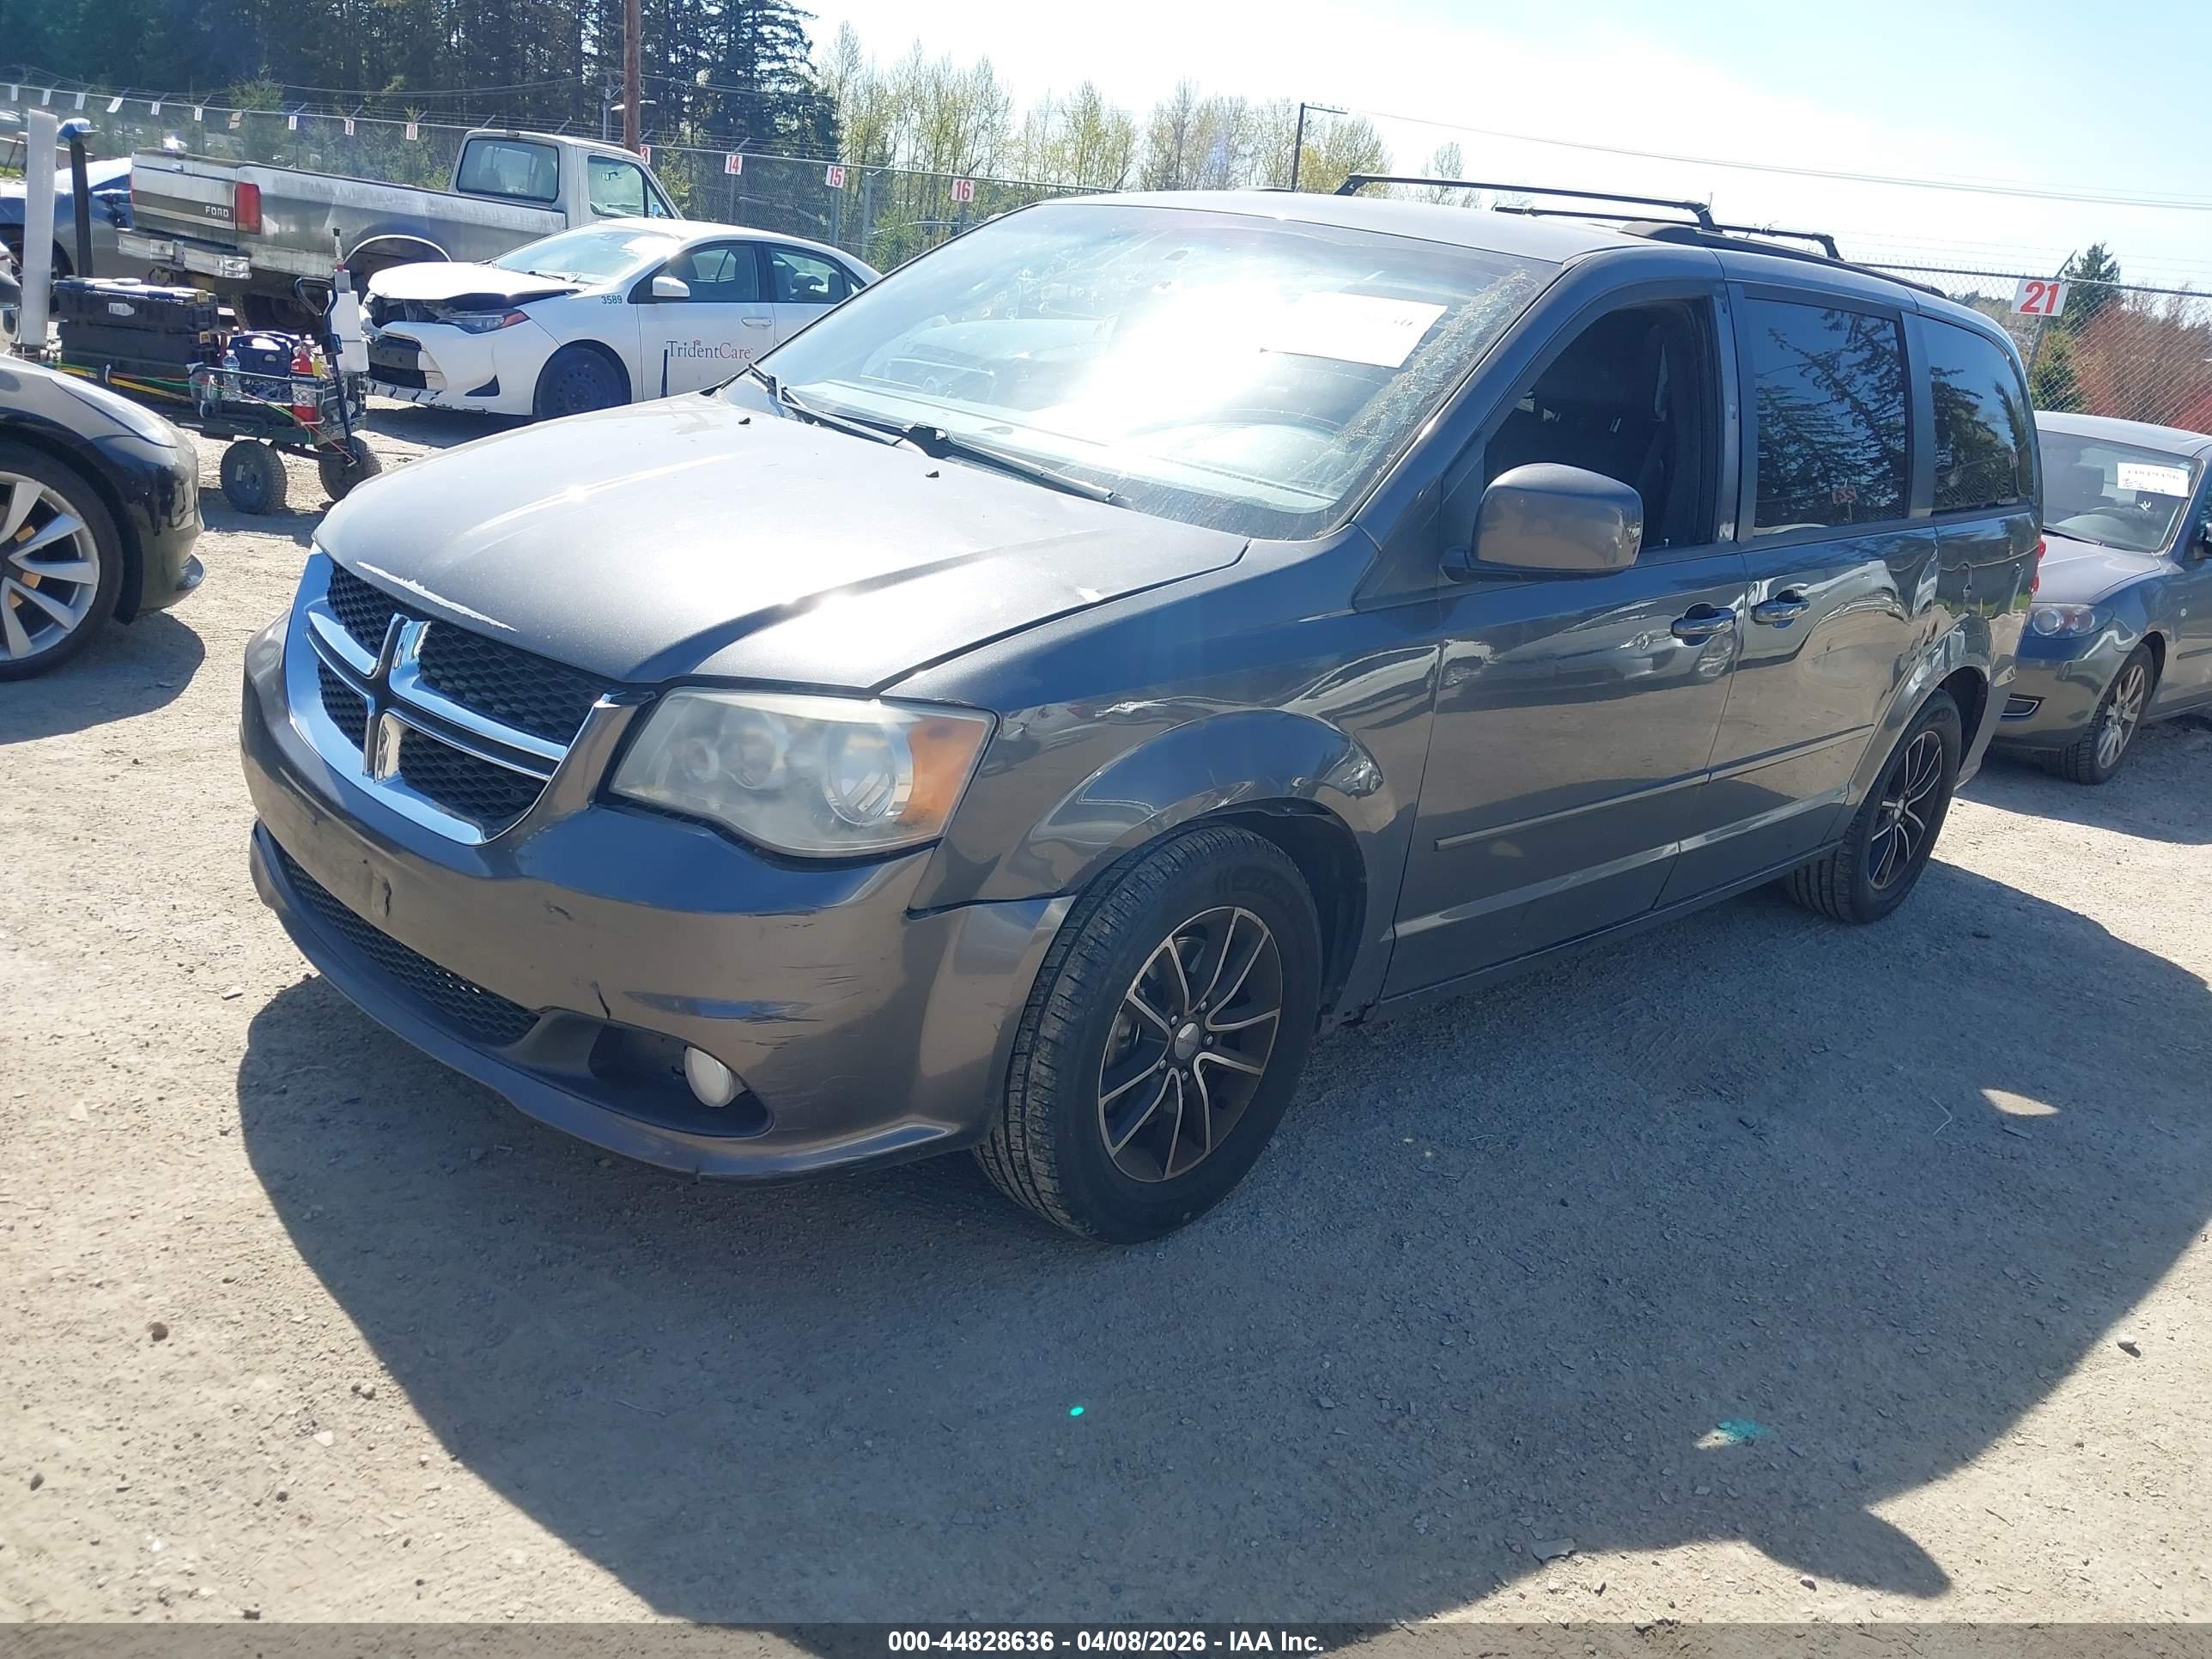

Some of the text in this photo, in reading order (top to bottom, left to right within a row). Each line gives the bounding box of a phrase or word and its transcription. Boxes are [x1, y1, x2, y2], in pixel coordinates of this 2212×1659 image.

[728, 155, 739, 173] 14
[830, 166, 842, 186] 15
[956, 180, 971, 201] 16
[205, 205, 229, 218] FORD
[601, 295, 623, 305] 3589
[2019, 281, 2061, 314] 21
[665, 340, 751, 359] TridentCare
